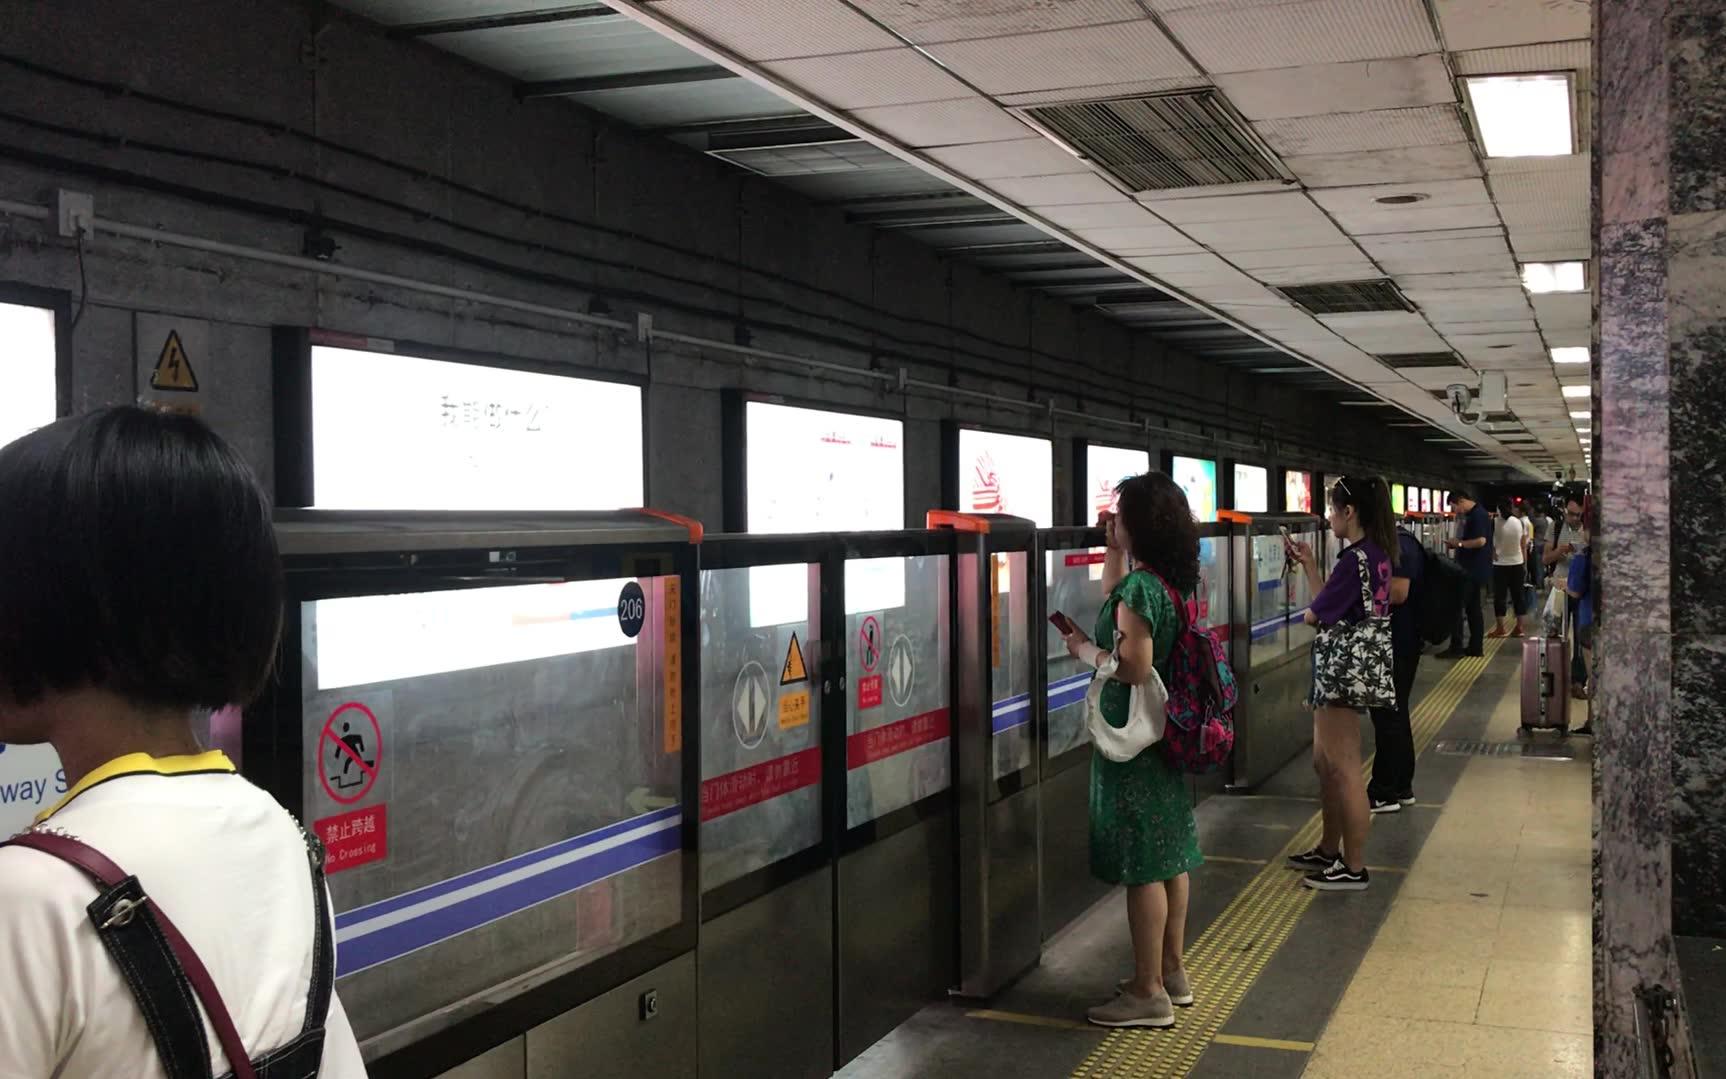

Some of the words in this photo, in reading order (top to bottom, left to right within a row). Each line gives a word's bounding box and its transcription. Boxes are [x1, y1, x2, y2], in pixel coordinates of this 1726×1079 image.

[620, 599, 643, 621] 206
[0, 778, 47, 805] way
[326, 814, 377, 844] 禁止跨越
[339, 842, 377, 861] Crossing
